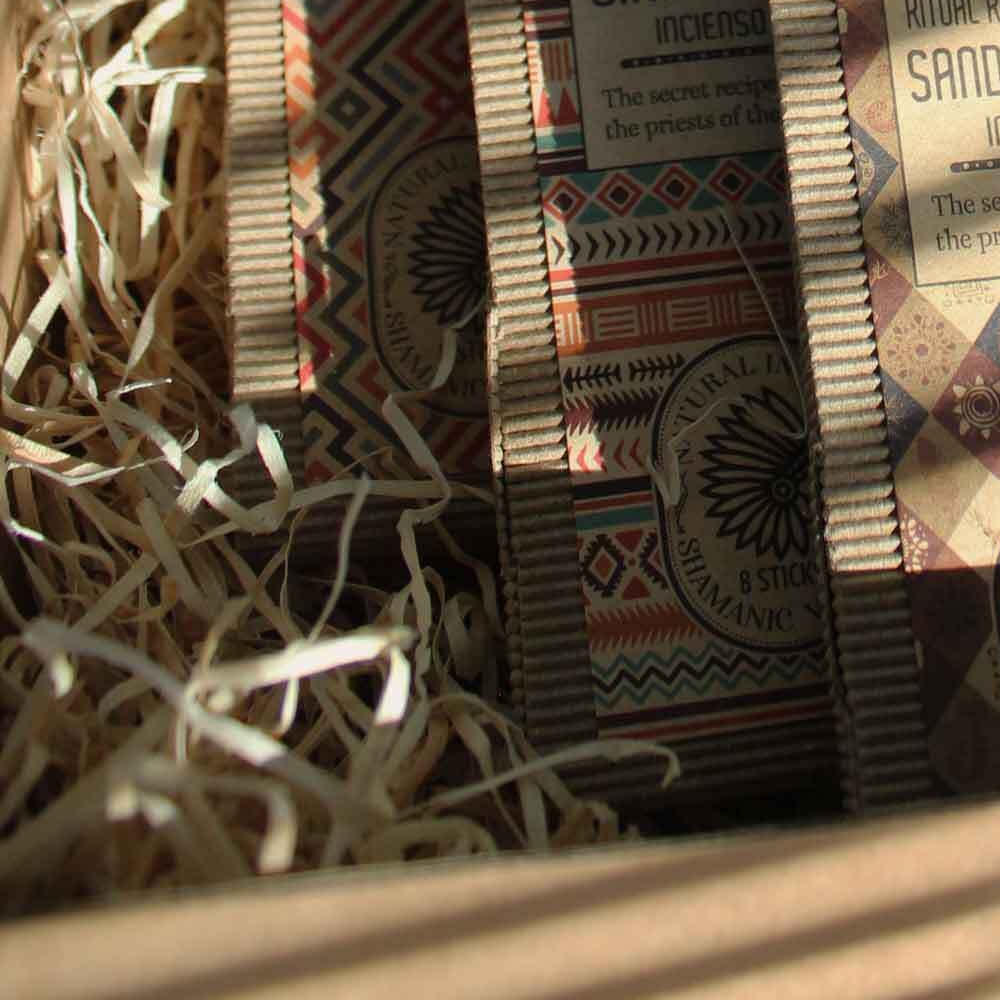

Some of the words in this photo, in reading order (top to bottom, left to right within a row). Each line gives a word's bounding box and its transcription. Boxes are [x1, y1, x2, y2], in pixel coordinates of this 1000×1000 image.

[655, 8, 768, 45] INCIENSO
[601, 87, 643, 109] The
[649, 81, 713, 106] secret
[605, 118, 641, 141] the
[645, 112, 714, 142] priests
[719, 105, 742, 126] of
[932, 193, 976, 218] The
[935, 229, 973, 253] the
[676, 538, 792, 633] SHAMANIC
[739, 569, 752, 595] 8
